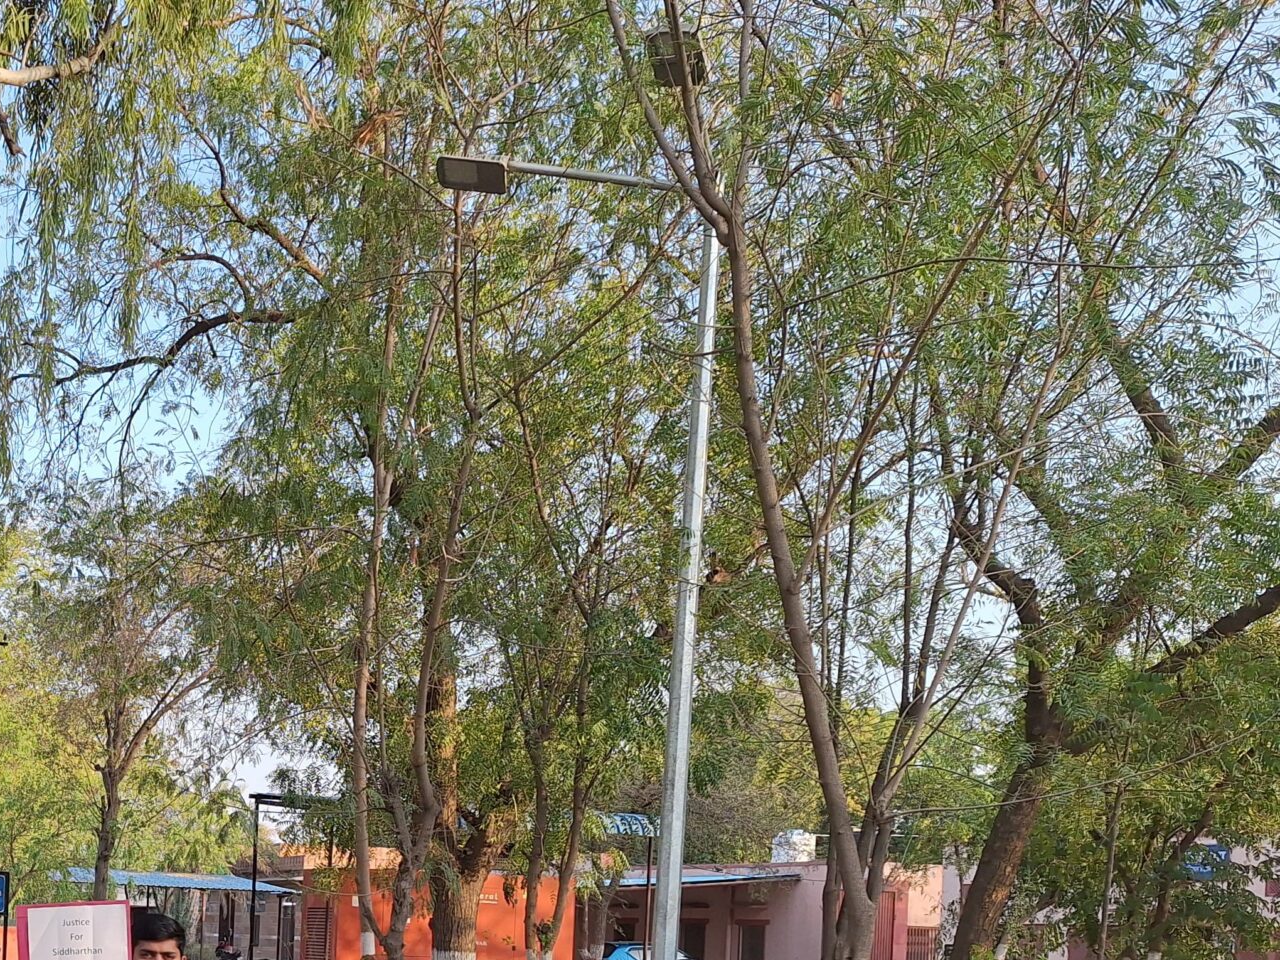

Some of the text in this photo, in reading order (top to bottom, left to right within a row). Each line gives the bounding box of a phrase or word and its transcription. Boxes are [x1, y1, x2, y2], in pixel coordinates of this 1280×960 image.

[62, 919, 91, 927] Justice
[70, 932, 84, 941] For
[52, 946, 103, 956] Siddharthan
